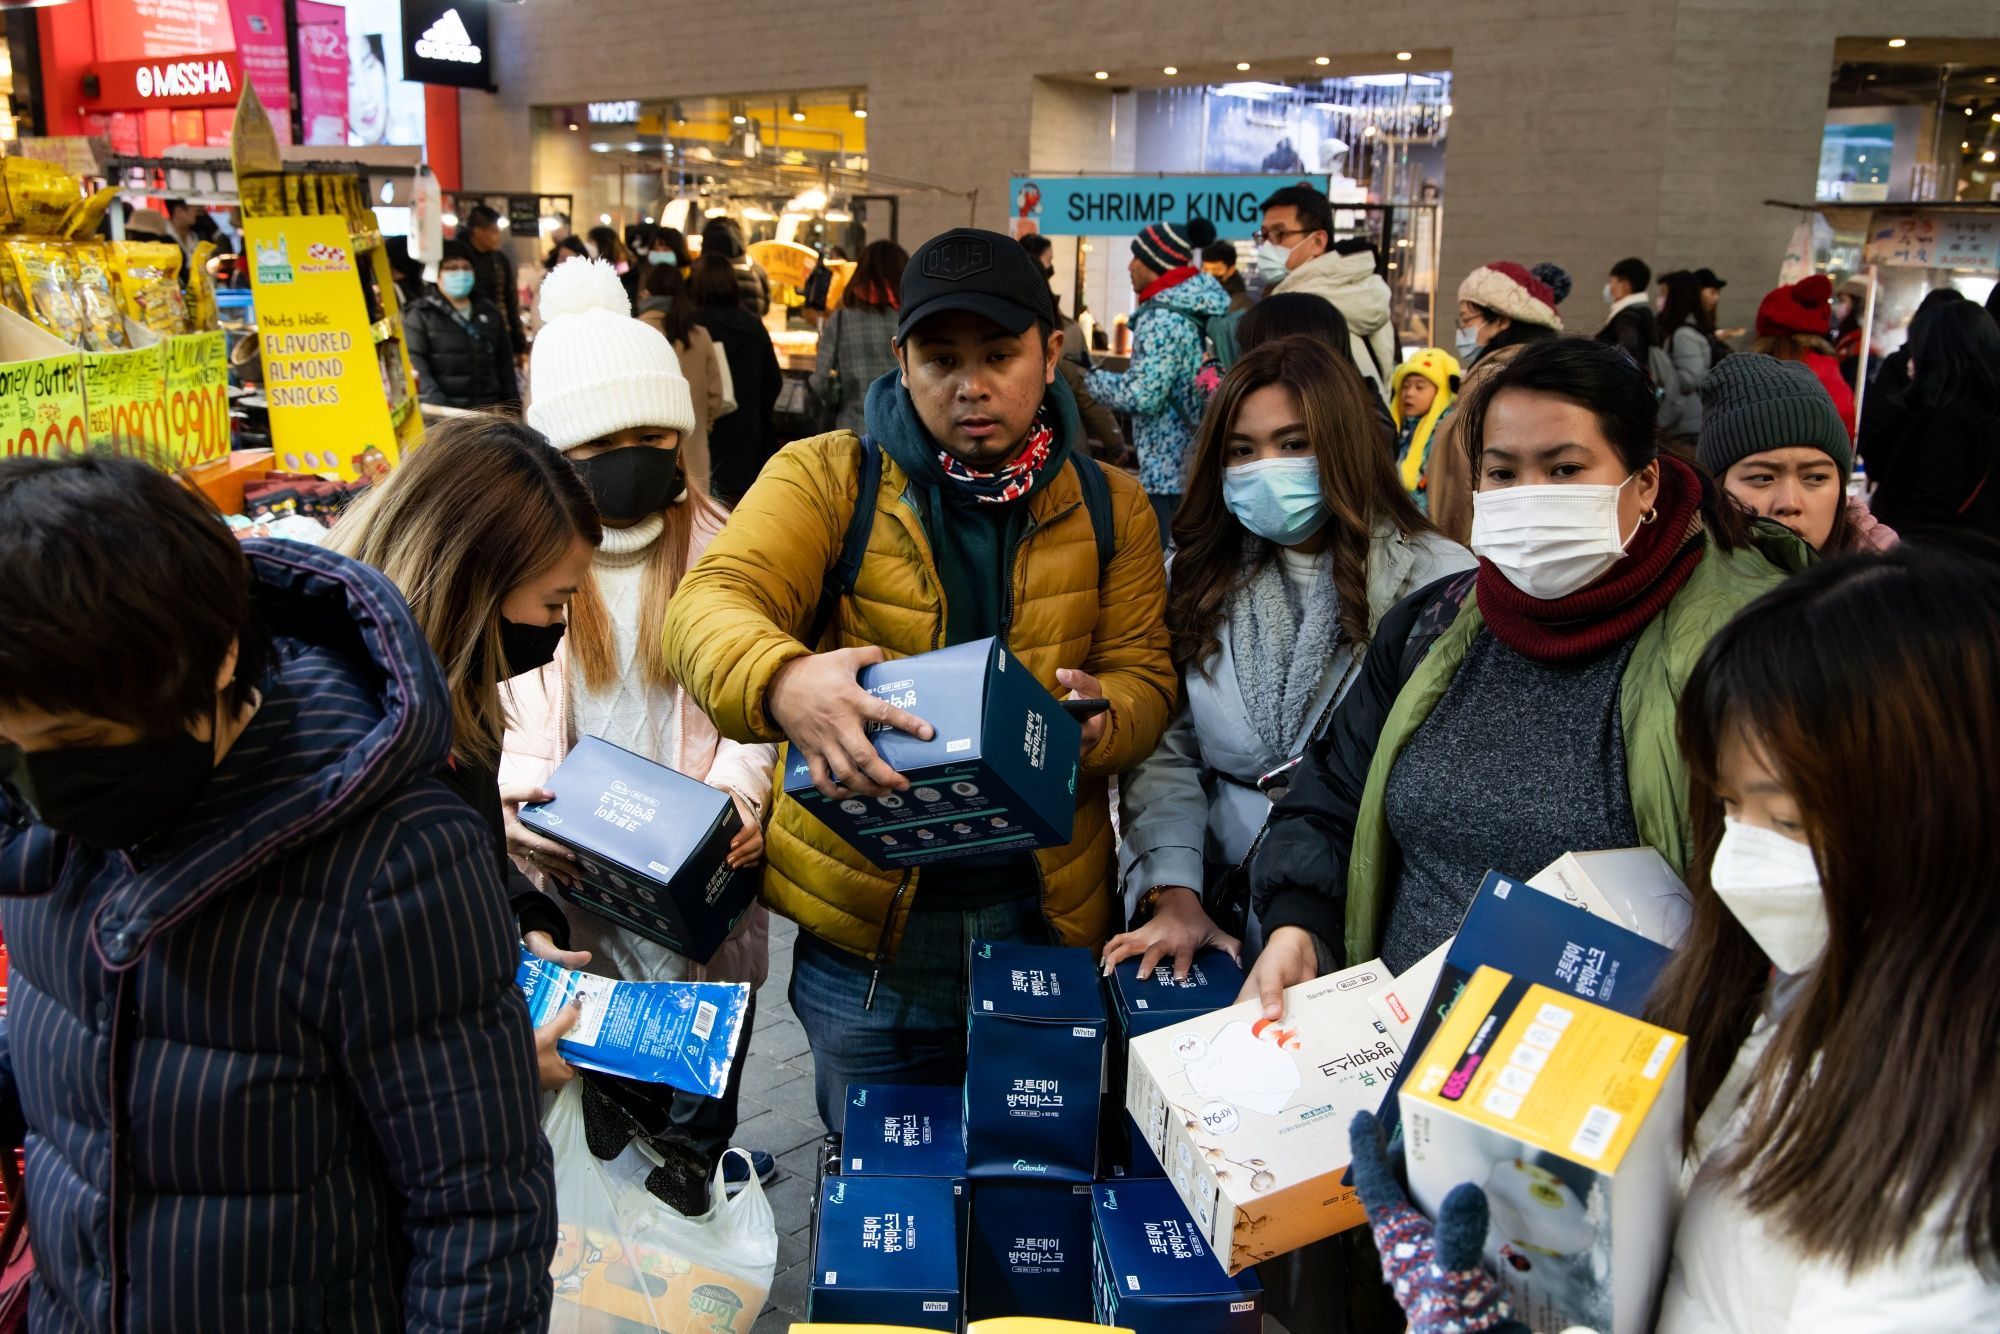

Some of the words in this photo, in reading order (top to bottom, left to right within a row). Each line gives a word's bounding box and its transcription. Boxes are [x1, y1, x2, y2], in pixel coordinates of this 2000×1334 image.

[153, 60, 232, 97] MISSHA
[1068, 192, 1175, 222] SHRIMP
[1186, 192, 1258, 222] KING
[263, 314, 295, 328] Nuts
[300, 312, 331, 326] Holic
[265, 331, 352, 355] FLAVORED
[34, 362, 80, 397] Butter
[269, 357, 344, 382] ALMOND
[272, 385, 340, 408] SNACKS
[171, 383, 229, 466] 9900
[593, 805, 643, 833] 코튼데이
[600, 791, 656, 823] 방역마스크
[1555, 941, 1586, 984] 코튼데이
[1574, 947, 1606, 998] 방역마스크
[1074, 1027, 1096, 1037] White
[1318, 1041, 1395, 1077] 방역마스크
[1012, 1079, 1059, 1093] 코튼데이
[1358, 1070, 1378, 1087] 휴
[1006, 1094, 1064, 1108] 방역마스크
[884, 1116, 901, 1144] 코튼데이
[1203, 1107, 1232, 1127] KF94
[903, 1114, 920, 1147] 방역마스크
[1014, 1161, 1048, 1174] Cottonday
[1073, 1186, 1092, 1194] Whit
[863, 1216, 881, 1250] 코튼데이
[883, 1212, 902, 1253] 방역마스크
[1013, 1237, 1060, 1251] 코튼데이
[1144, 1222, 1168, 1255] 코튼데이
[1163, 1219, 1192, 1259] 방역마스크
[1008, 1251, 1065, 1265] 방역마스크
[924, 1302, 948, 1311] White
[1231, 1303, 1253, 1312] White
